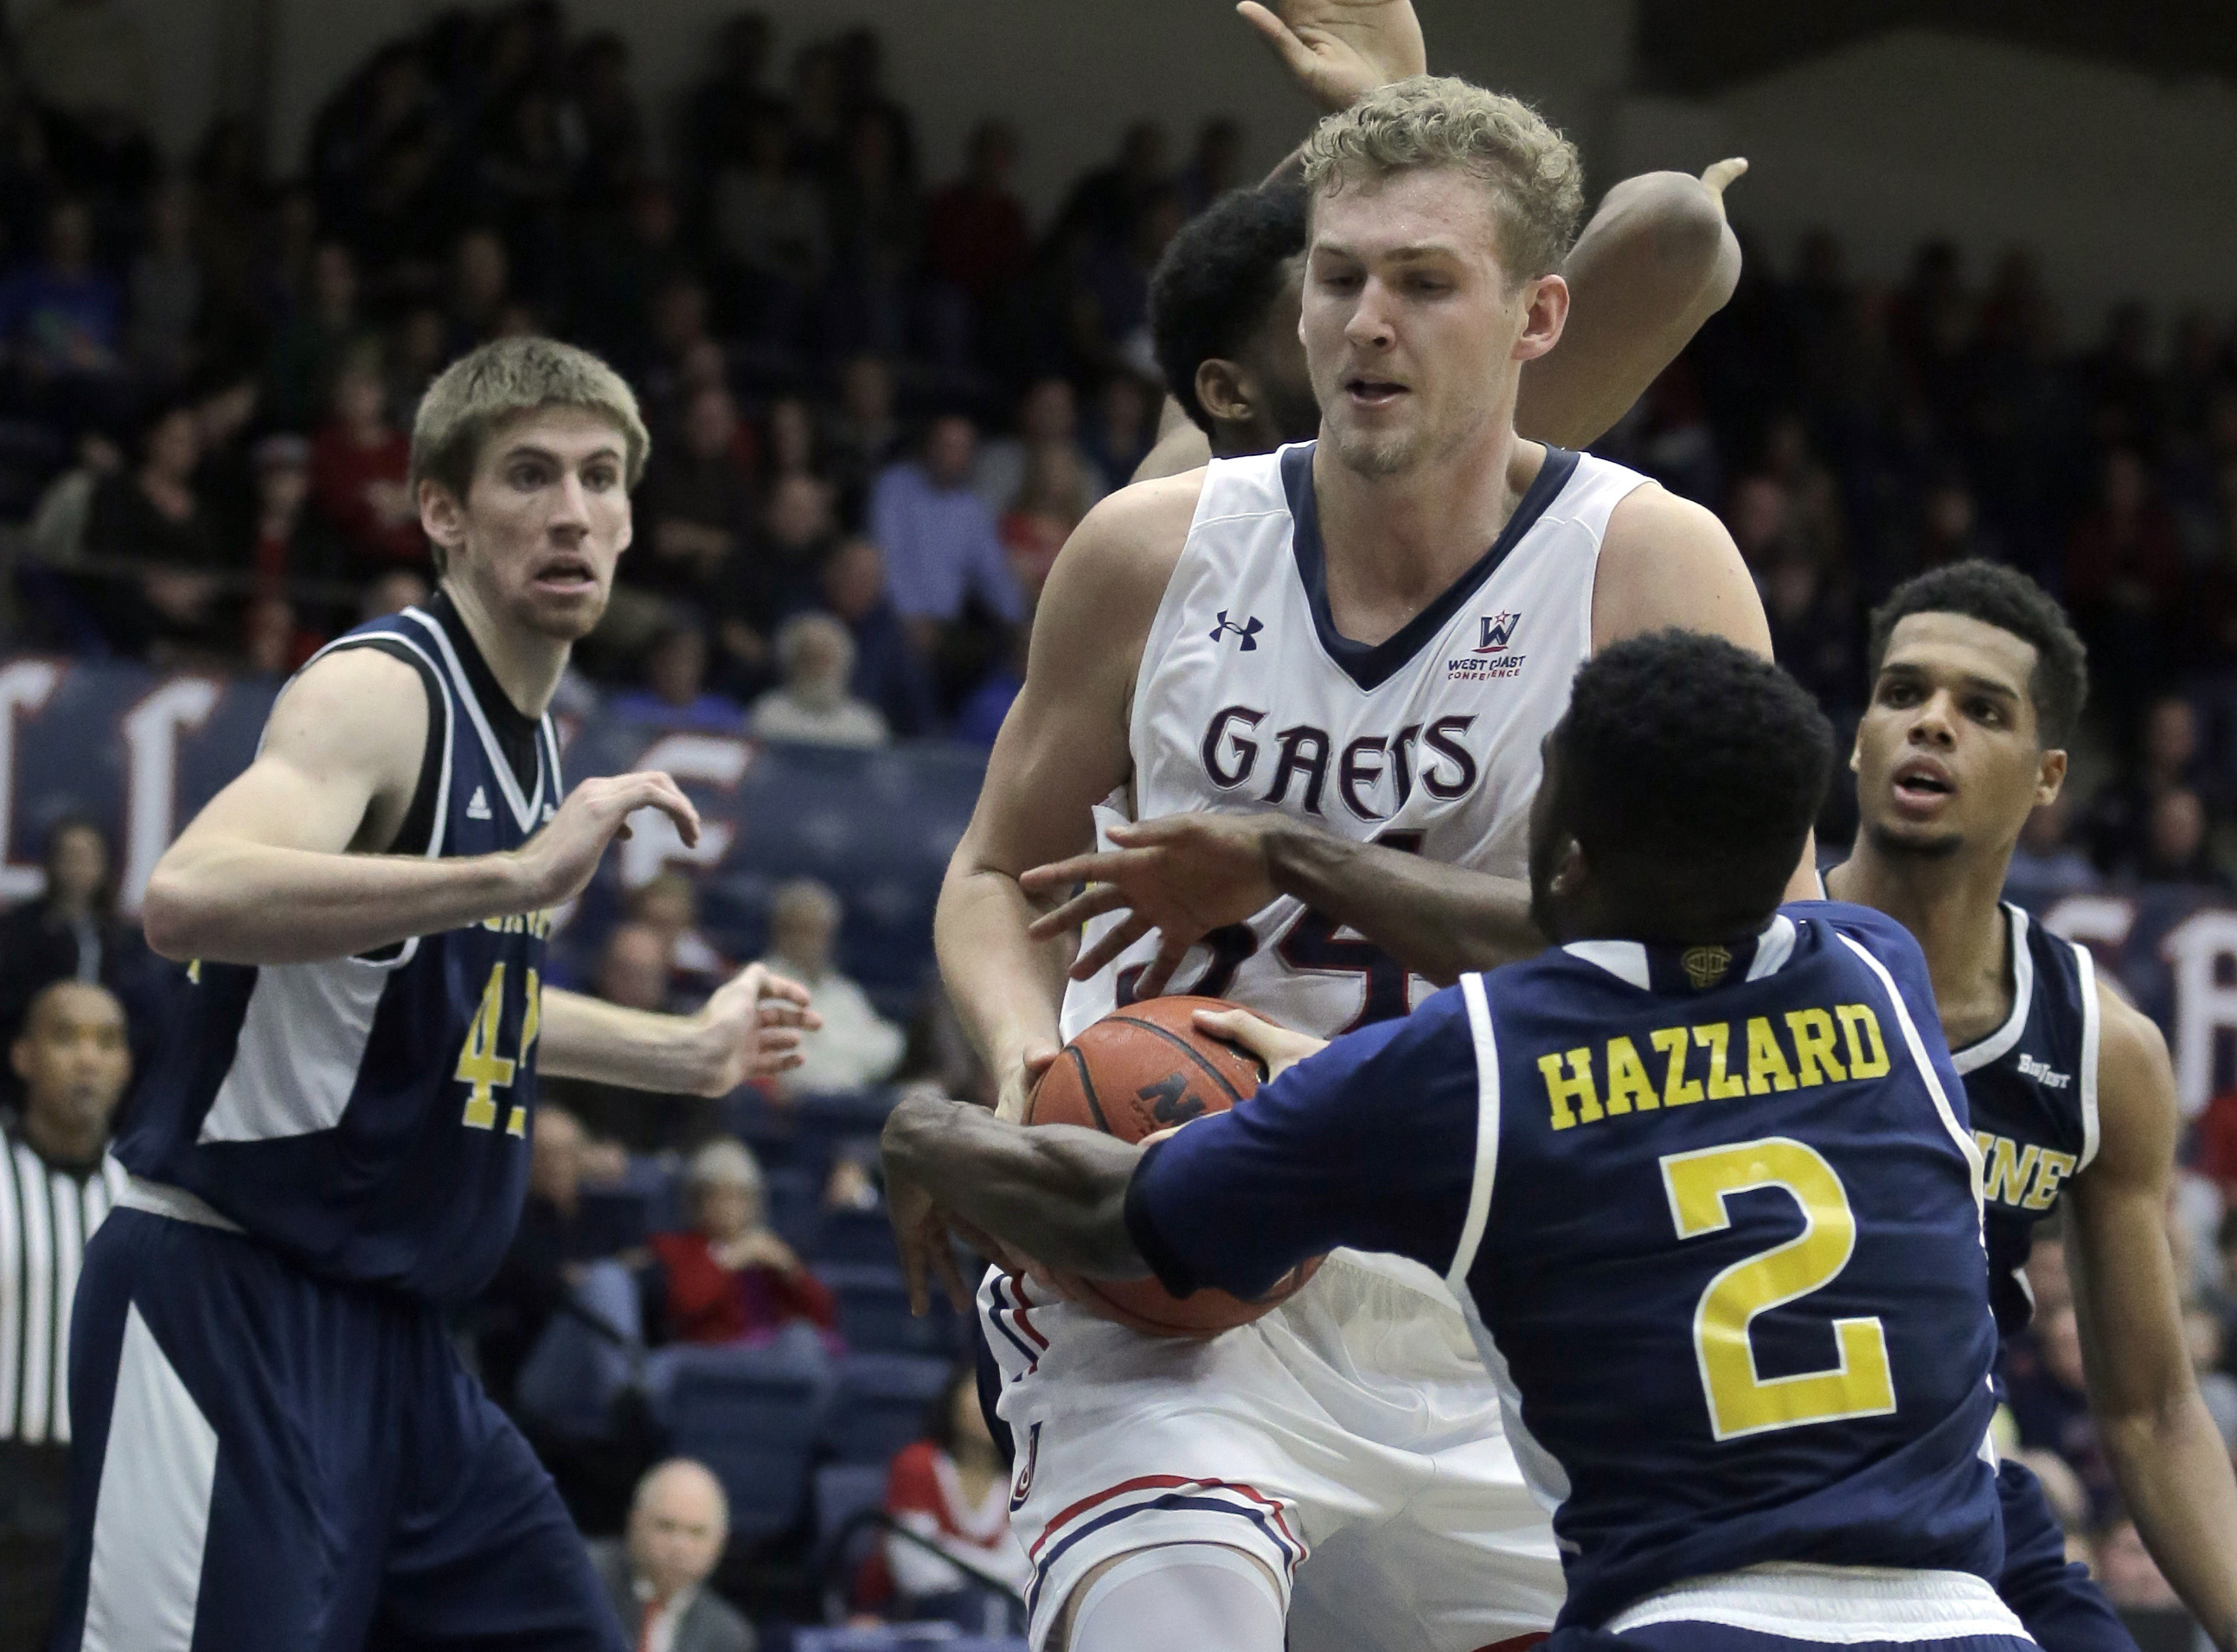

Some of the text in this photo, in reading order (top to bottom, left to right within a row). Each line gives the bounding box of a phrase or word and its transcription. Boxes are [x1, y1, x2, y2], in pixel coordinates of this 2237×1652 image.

[1447, 658, 1488, 671] WEST
[1536, 1003, 1891, 1132] HAZZARD
[1657, 1135, 1897, 1442] 2
